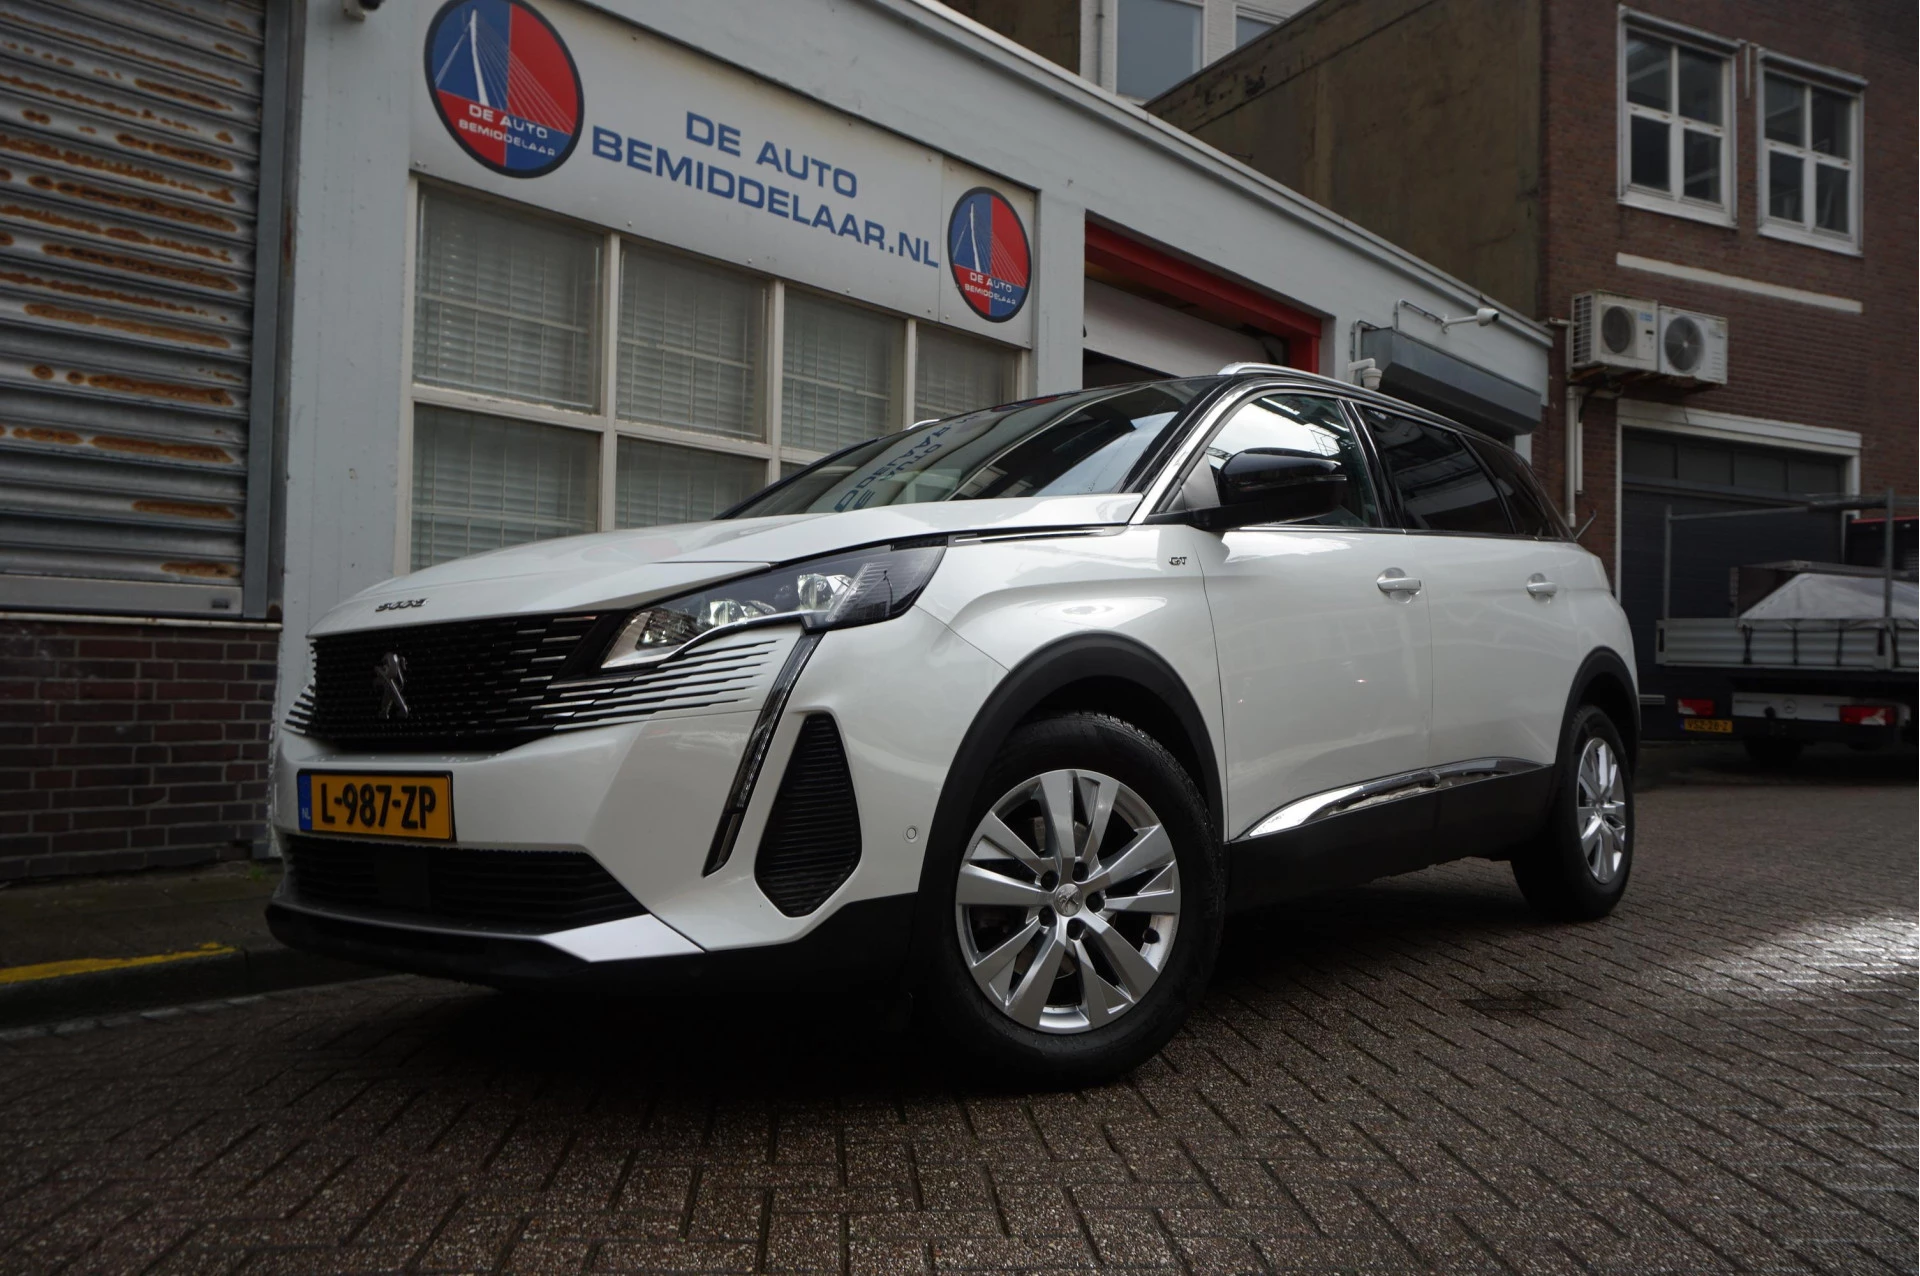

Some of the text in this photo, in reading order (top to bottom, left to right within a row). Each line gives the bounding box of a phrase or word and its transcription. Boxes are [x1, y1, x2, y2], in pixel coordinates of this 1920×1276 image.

[458, 119, 556, 156] BEMIDDELAAR
[468, 104, 548, 139] DE AUTO
[686, 111, 857, 199] DE AUTO
[592, 125, 939, 268] BEMIDDELAAR.NL
[964, 284, 1016, 305] BEMIDDELAAR
[970, 272, 1012, 292] DE AUTO
[1169, 556, 1187, 566] GT
[301, 807, 311, 820] NL
[321, 783, 436, 830] L-987-ZP
